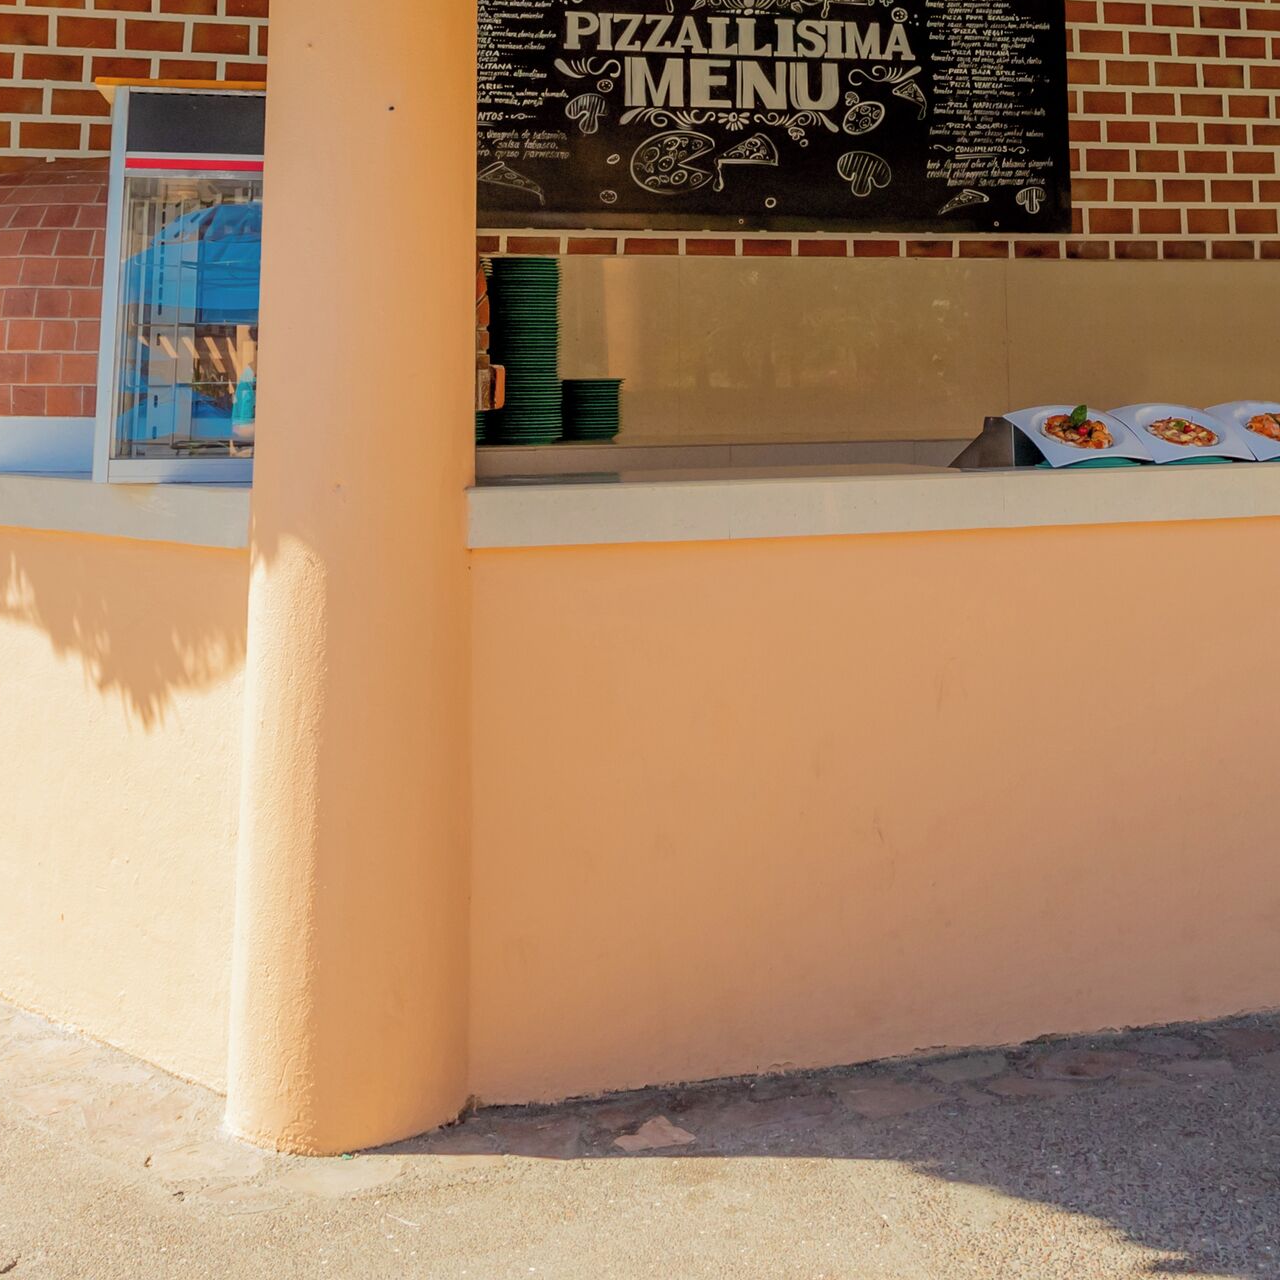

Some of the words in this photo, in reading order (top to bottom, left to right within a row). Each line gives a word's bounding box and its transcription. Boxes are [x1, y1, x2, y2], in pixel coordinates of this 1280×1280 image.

[564, 11, 914, 60] PIZZALLISIMA
[624, 57, 839, 109] MENU
[478, 112, 503, 120] NTOS
